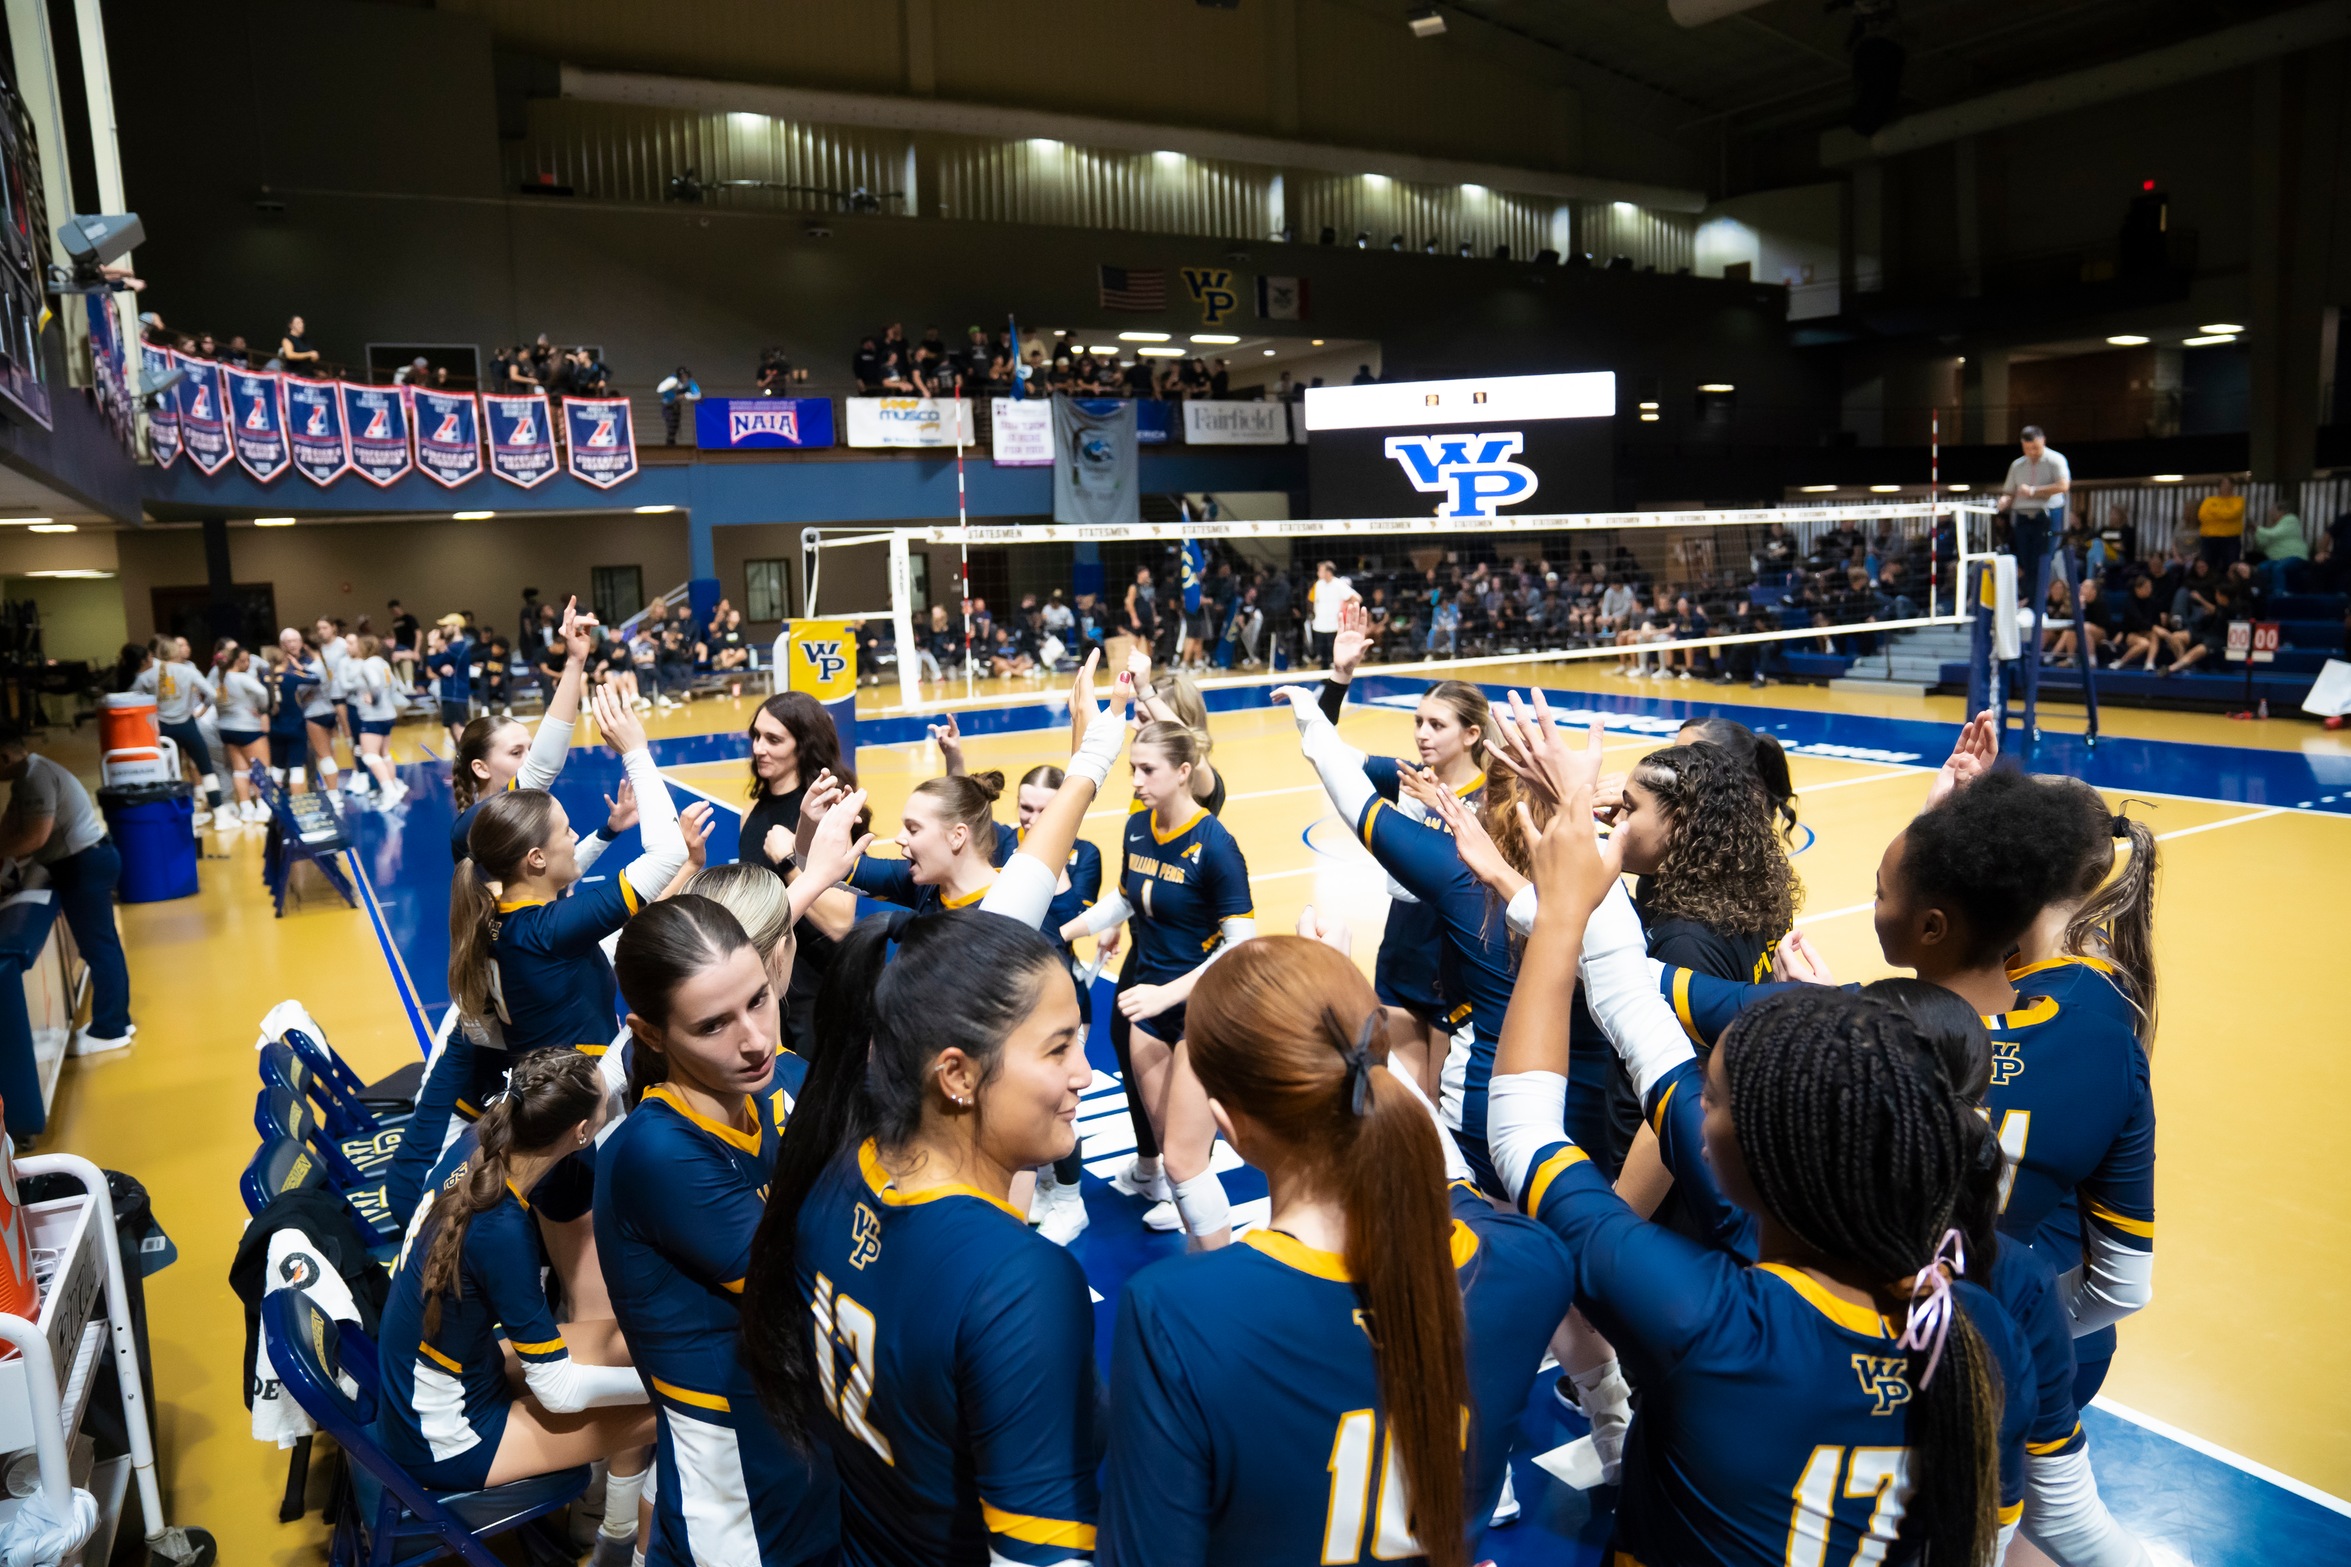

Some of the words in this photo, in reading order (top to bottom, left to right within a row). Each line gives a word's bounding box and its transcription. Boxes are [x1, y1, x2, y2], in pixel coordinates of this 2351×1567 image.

[1181, 267, 1237, 325] WP
[734, 415, 793, 436] NAIA
[1194, 407, 1276, 430] Fairfield
[1385, 432, 1539, 518] WP
[968, 529, 1022, 539] STATESMEN
[1078, 528, 1130, 537] STATESMEN
[1182, 525, 1230, 535] STATESMEN
[2228, 628, 2249, 645] 00
[2254, 628, 2279, 649] 00
[799, 639, 847, 683] WP
[1128, 852, 1158, 877] WILLIAM
[1158, 862, 1186, 885] PENN
[1141, 879, 1154, 918] 1
[848, 1201, 883, 1271] WP
[810, 1271, 895, 1467] 12
[1851, 1353, 1914, 1416] WP
[1785, 1444, 1916, 1567] 17
